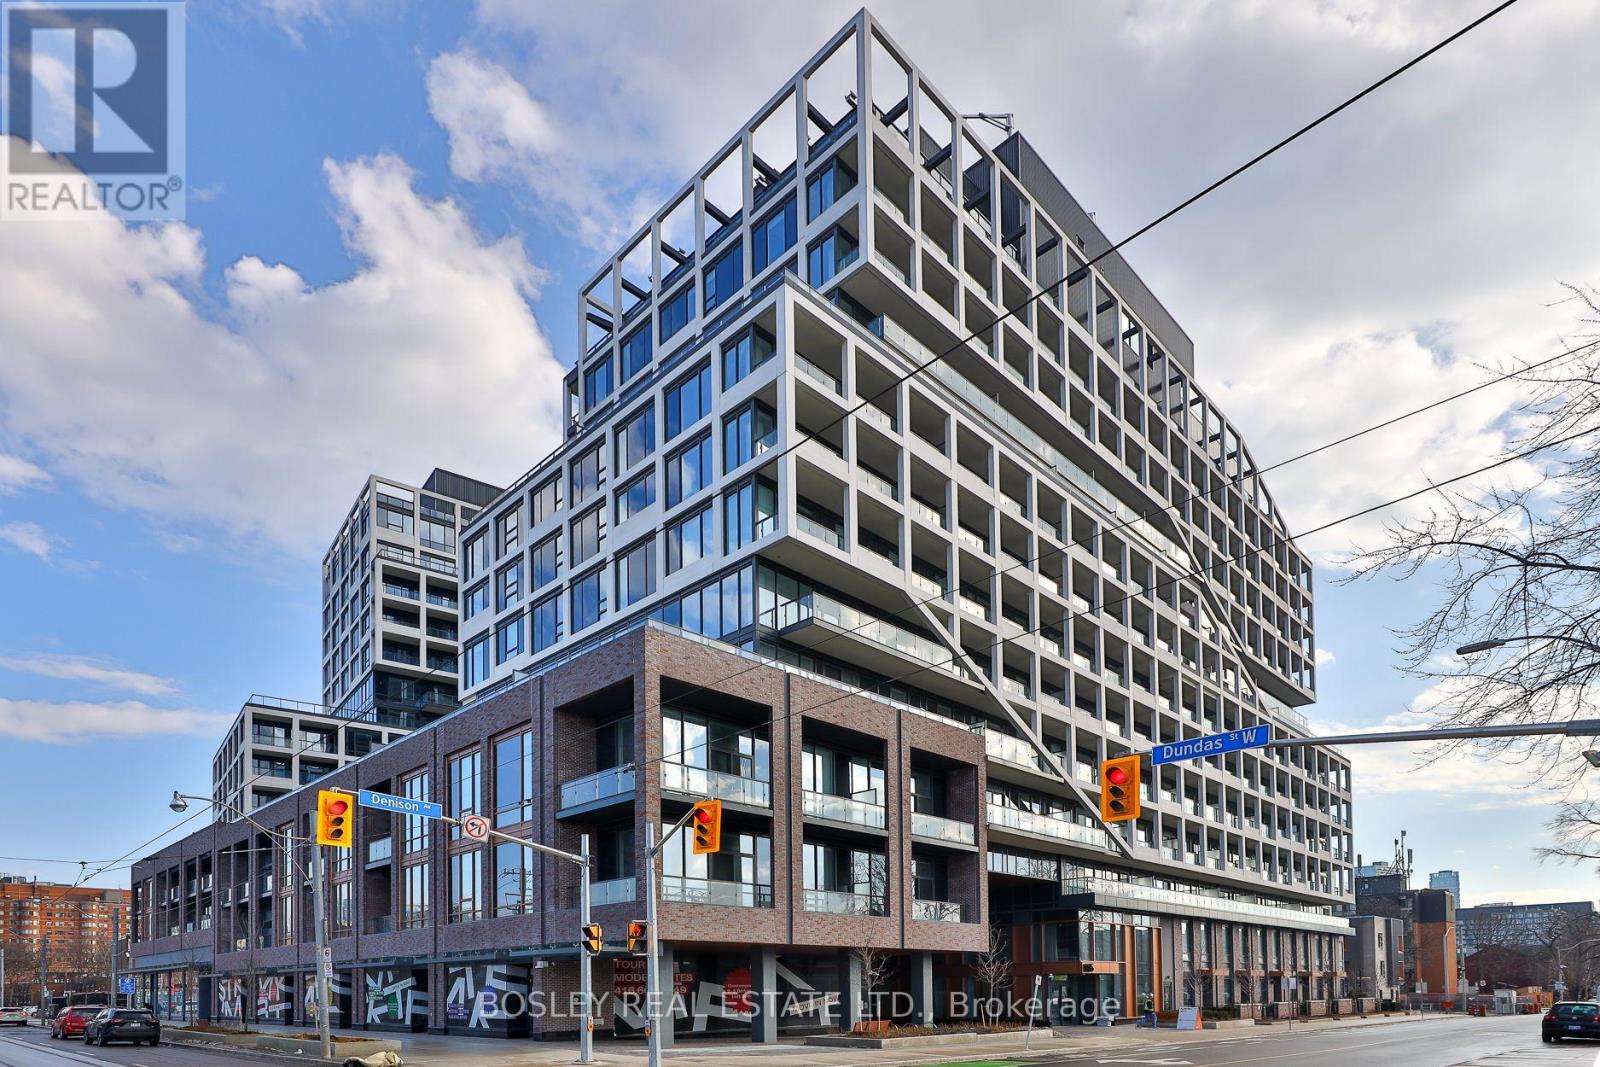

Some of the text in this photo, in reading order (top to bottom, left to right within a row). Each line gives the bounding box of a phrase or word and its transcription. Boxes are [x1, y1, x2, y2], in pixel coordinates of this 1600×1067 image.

[1163, 729, 1257, 759] Dundas St W
[371, 793, 419, 812] Denison
[615, 960, 645, 969] TOUR
